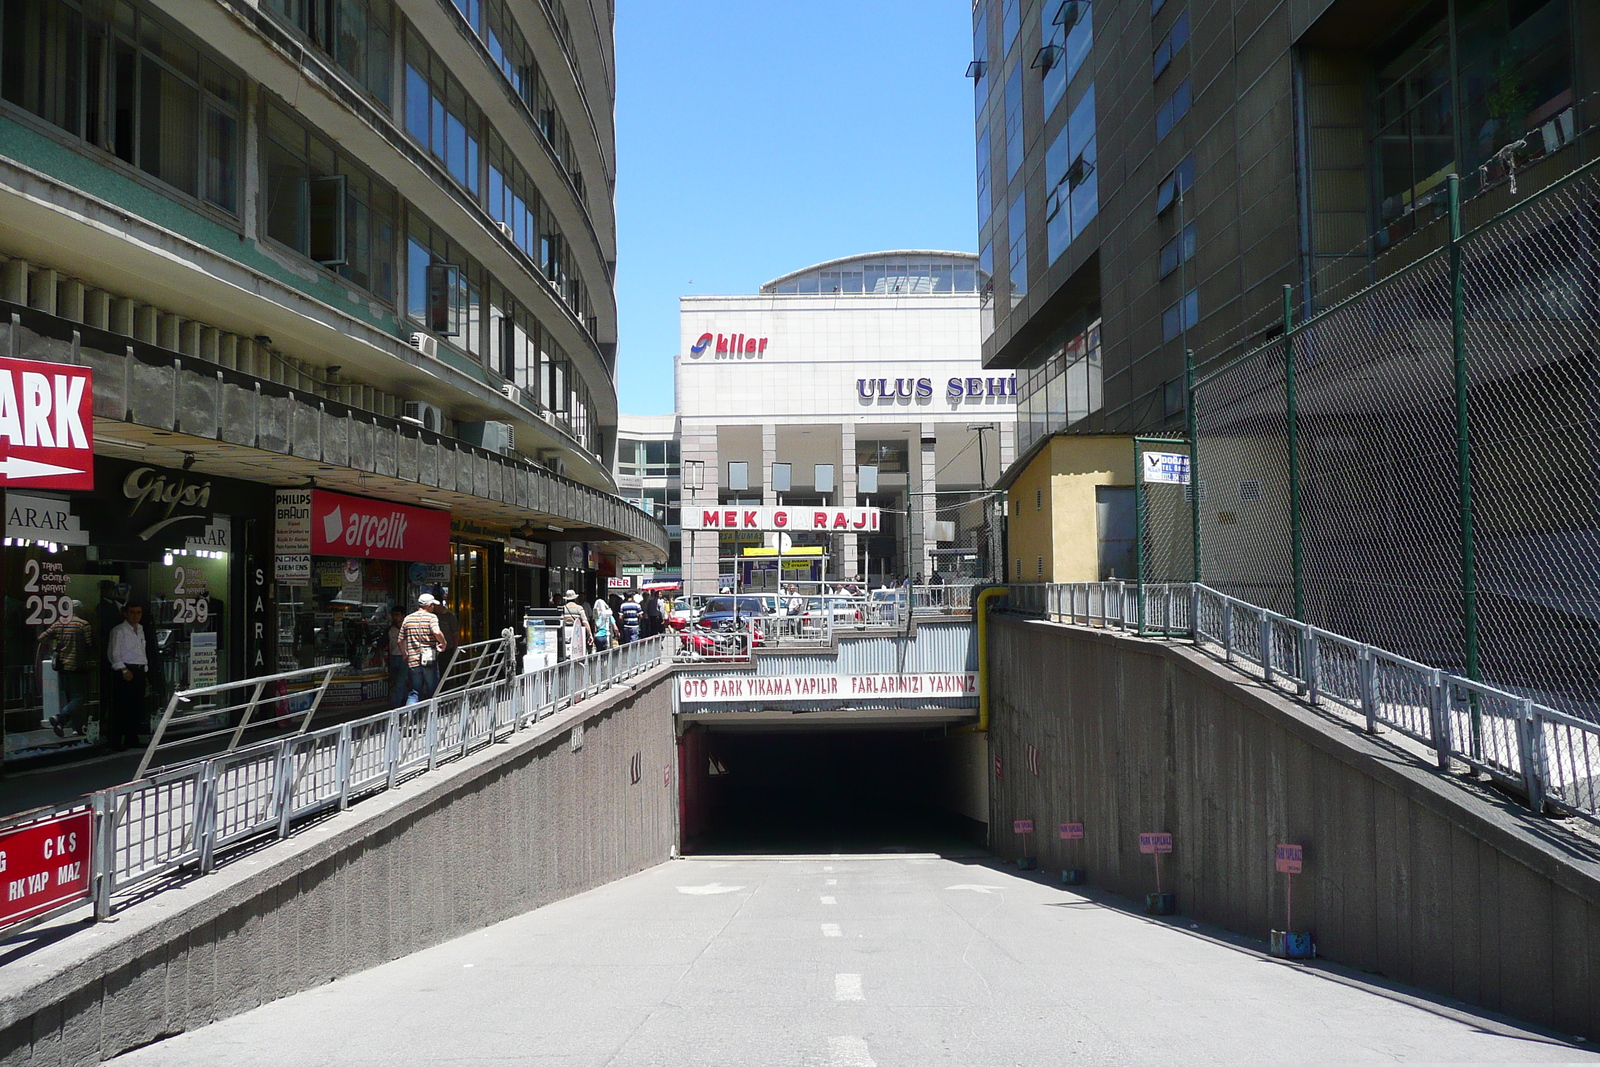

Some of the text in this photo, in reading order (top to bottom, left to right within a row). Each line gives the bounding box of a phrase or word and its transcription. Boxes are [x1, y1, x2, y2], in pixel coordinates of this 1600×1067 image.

[715, 333, 768, 354] kiler
[856, 377, 933, 398] ULUS
[276, 494, 311, 505] PHILIPS
[277, 506, 309, 519] BRAUN
[345, 511, 407, 556] arçelik
[275, 555, 310, 563] NOKIA
[24, 559, 40, 593] 2
[174, 566, 186, 595] 2
[25, 594, 74, 625] 259
[173, 598, 208, 624] 259
[684, 675, 976, 698] OTO PARK YIKAMA YAPILIR FARLARINIZI YAKINIZ
[58, 860, 81, 886] MAZ
